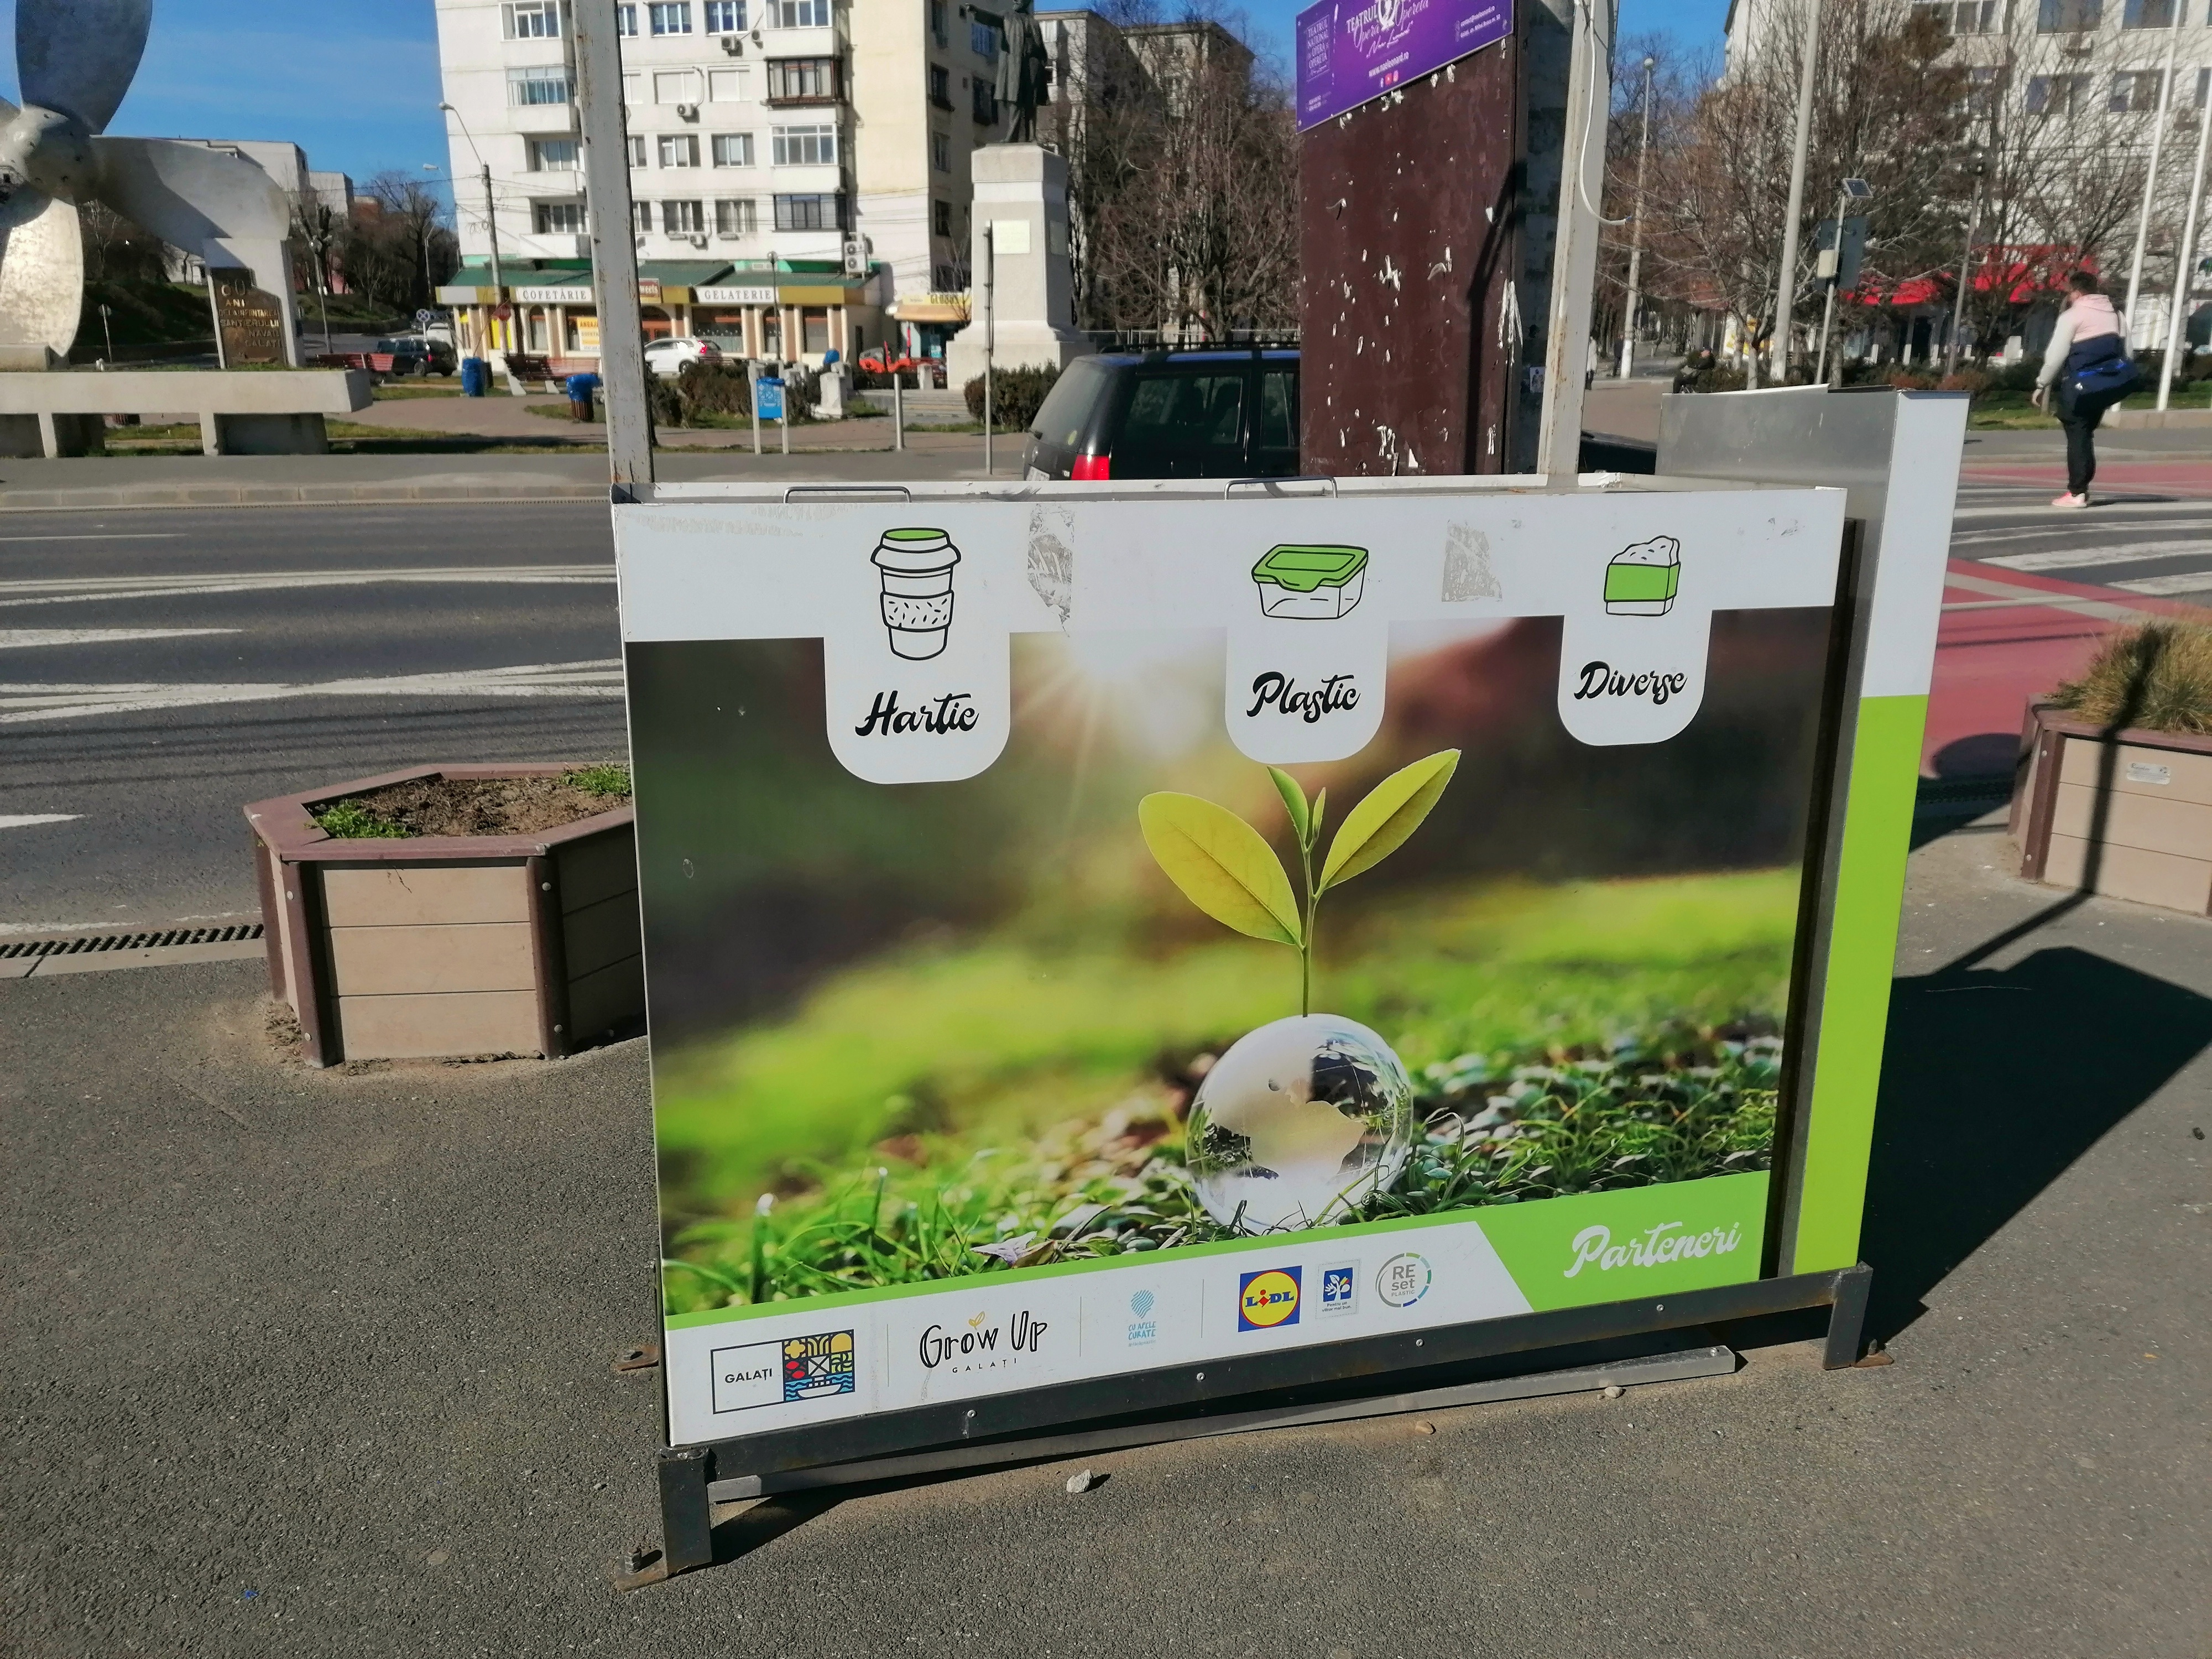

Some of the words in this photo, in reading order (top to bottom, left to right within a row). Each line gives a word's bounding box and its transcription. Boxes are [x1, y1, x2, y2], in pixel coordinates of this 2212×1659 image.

[1346, 4, 1378, 33] TEATRUL
[639, 284, 659, 294] weets
[704, 290, 771, 300] GELATERIE
[226, 299, 245, 307] ANI
[1574, 661, 1688, 705] Diverse
[1246, 671, 1361, 723] Plastic
[855, 690, 979, 736] Hartie
[1563, 1221, 1741, 1278] Parteneri
[1392, 1264, 1416, 1280] RE
[1391, 1278, 1415, 1291] set
[1128, 1329, 1156, 1340] CURATE
[1129, 1323, 1136, 1332] CU
[920, 1324, 999, 1368] Grow
